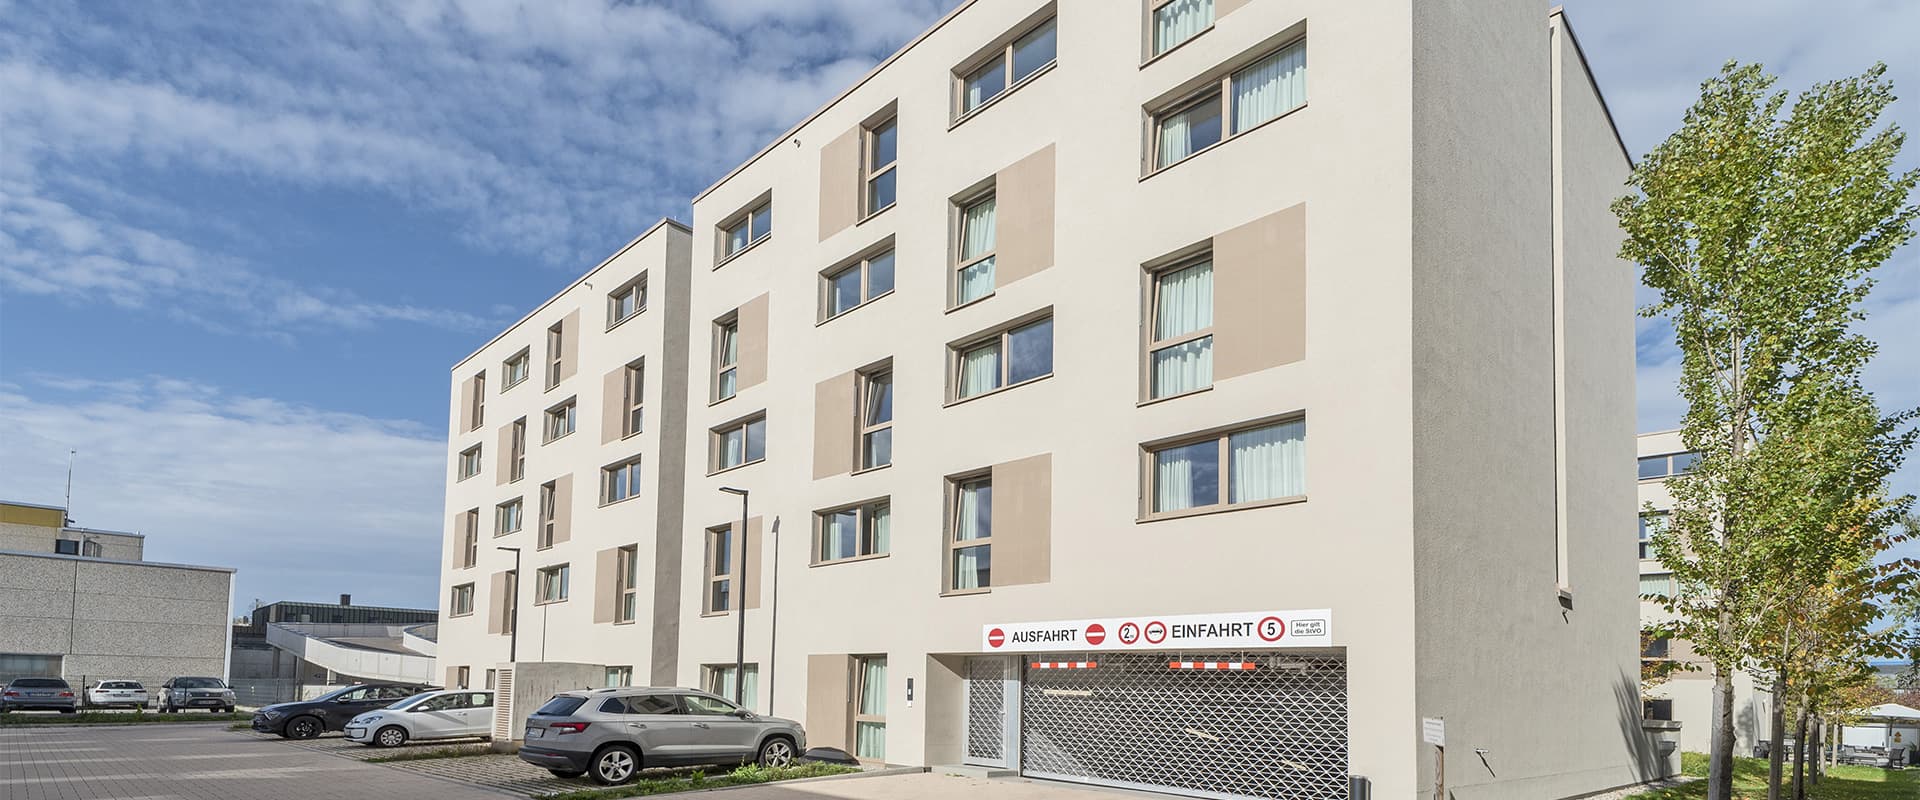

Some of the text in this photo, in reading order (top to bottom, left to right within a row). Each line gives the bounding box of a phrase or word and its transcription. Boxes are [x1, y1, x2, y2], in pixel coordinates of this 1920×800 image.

[1012, 629, 1077, 643] AUSFAHRT
[1171, 622, 1253, 638] EINFAHRT
[1266, 622, 1276, 636] 5
